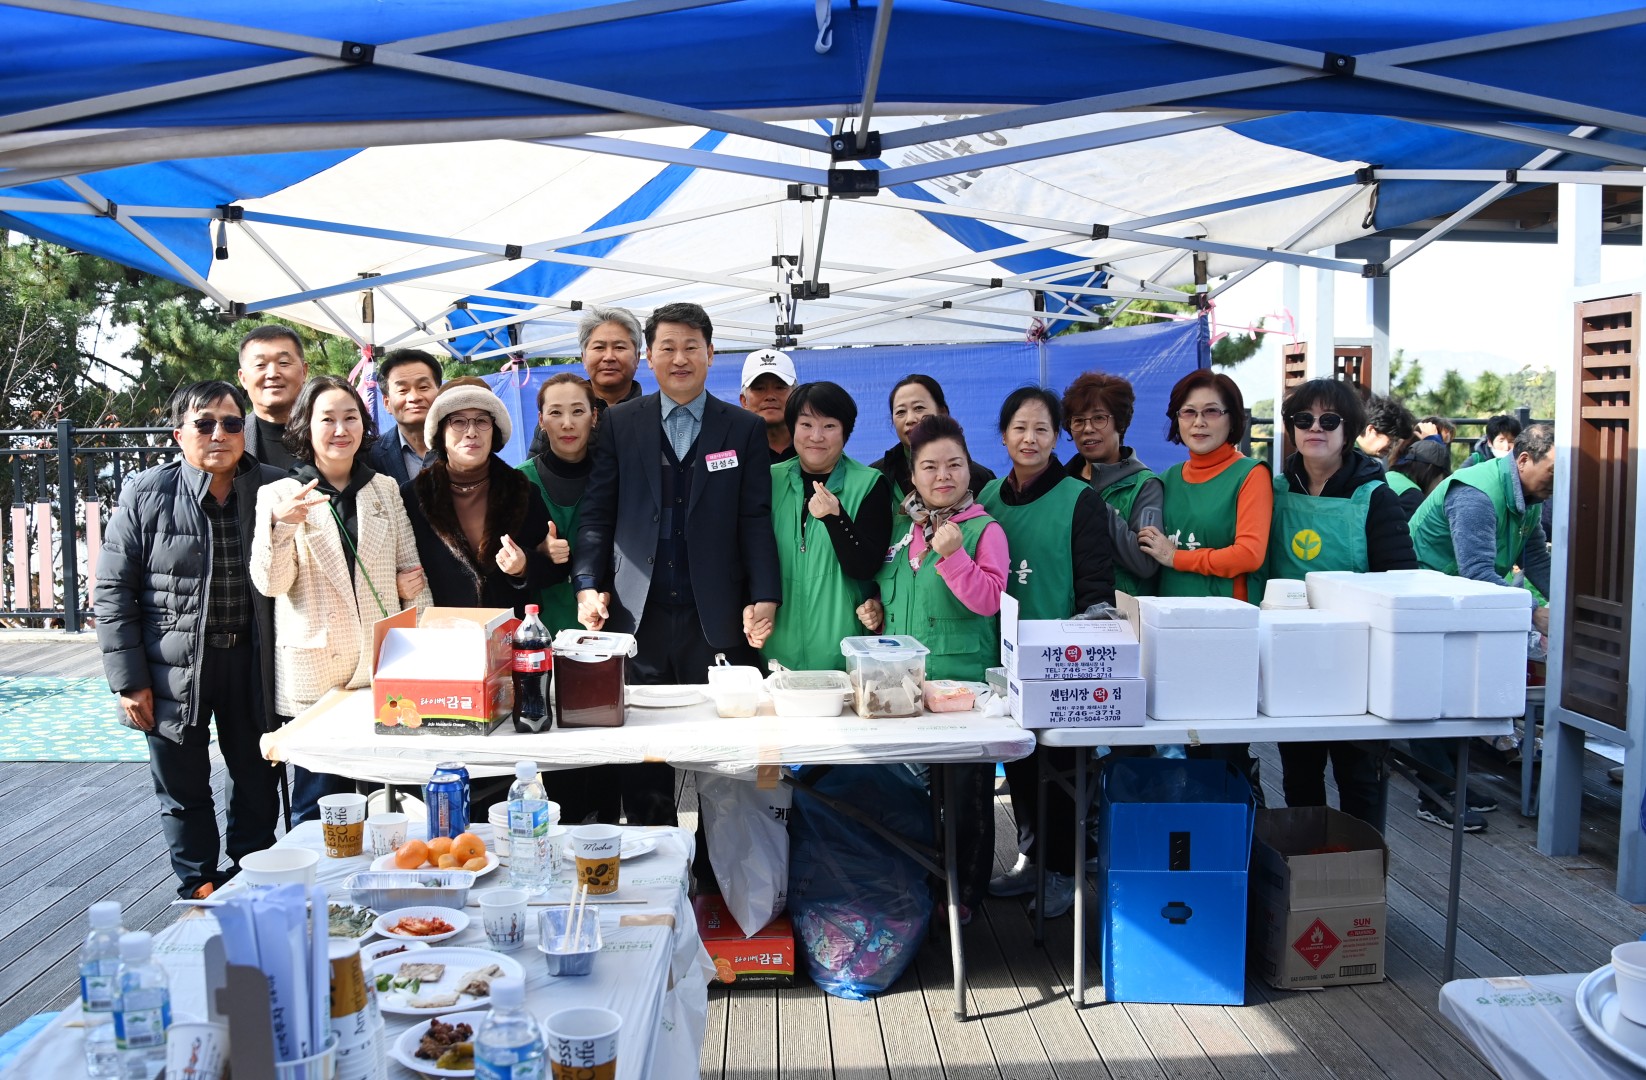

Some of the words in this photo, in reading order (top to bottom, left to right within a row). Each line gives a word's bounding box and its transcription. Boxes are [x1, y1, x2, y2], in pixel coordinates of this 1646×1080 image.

[711, 459, 736, 470] 김성수
[1041, 646, 1063, 662] 시장
[1067, 647, 1078, 660] 떡
[1086, 646, 1117, 661] 방앗간
[1050, 688, 1090, 702] 센텀시장
[1094, 688, 1105, 702] 떡
[1112, 687, 1122, 700] 집
[446, 695, 473, 710] 감귤
[582, 842, 613, 852] Mocha
[1354, 918, 1371, 926] SUN
[759, 953, 783, 965] 감귤
[1314, 954, 1320, 962] 2
